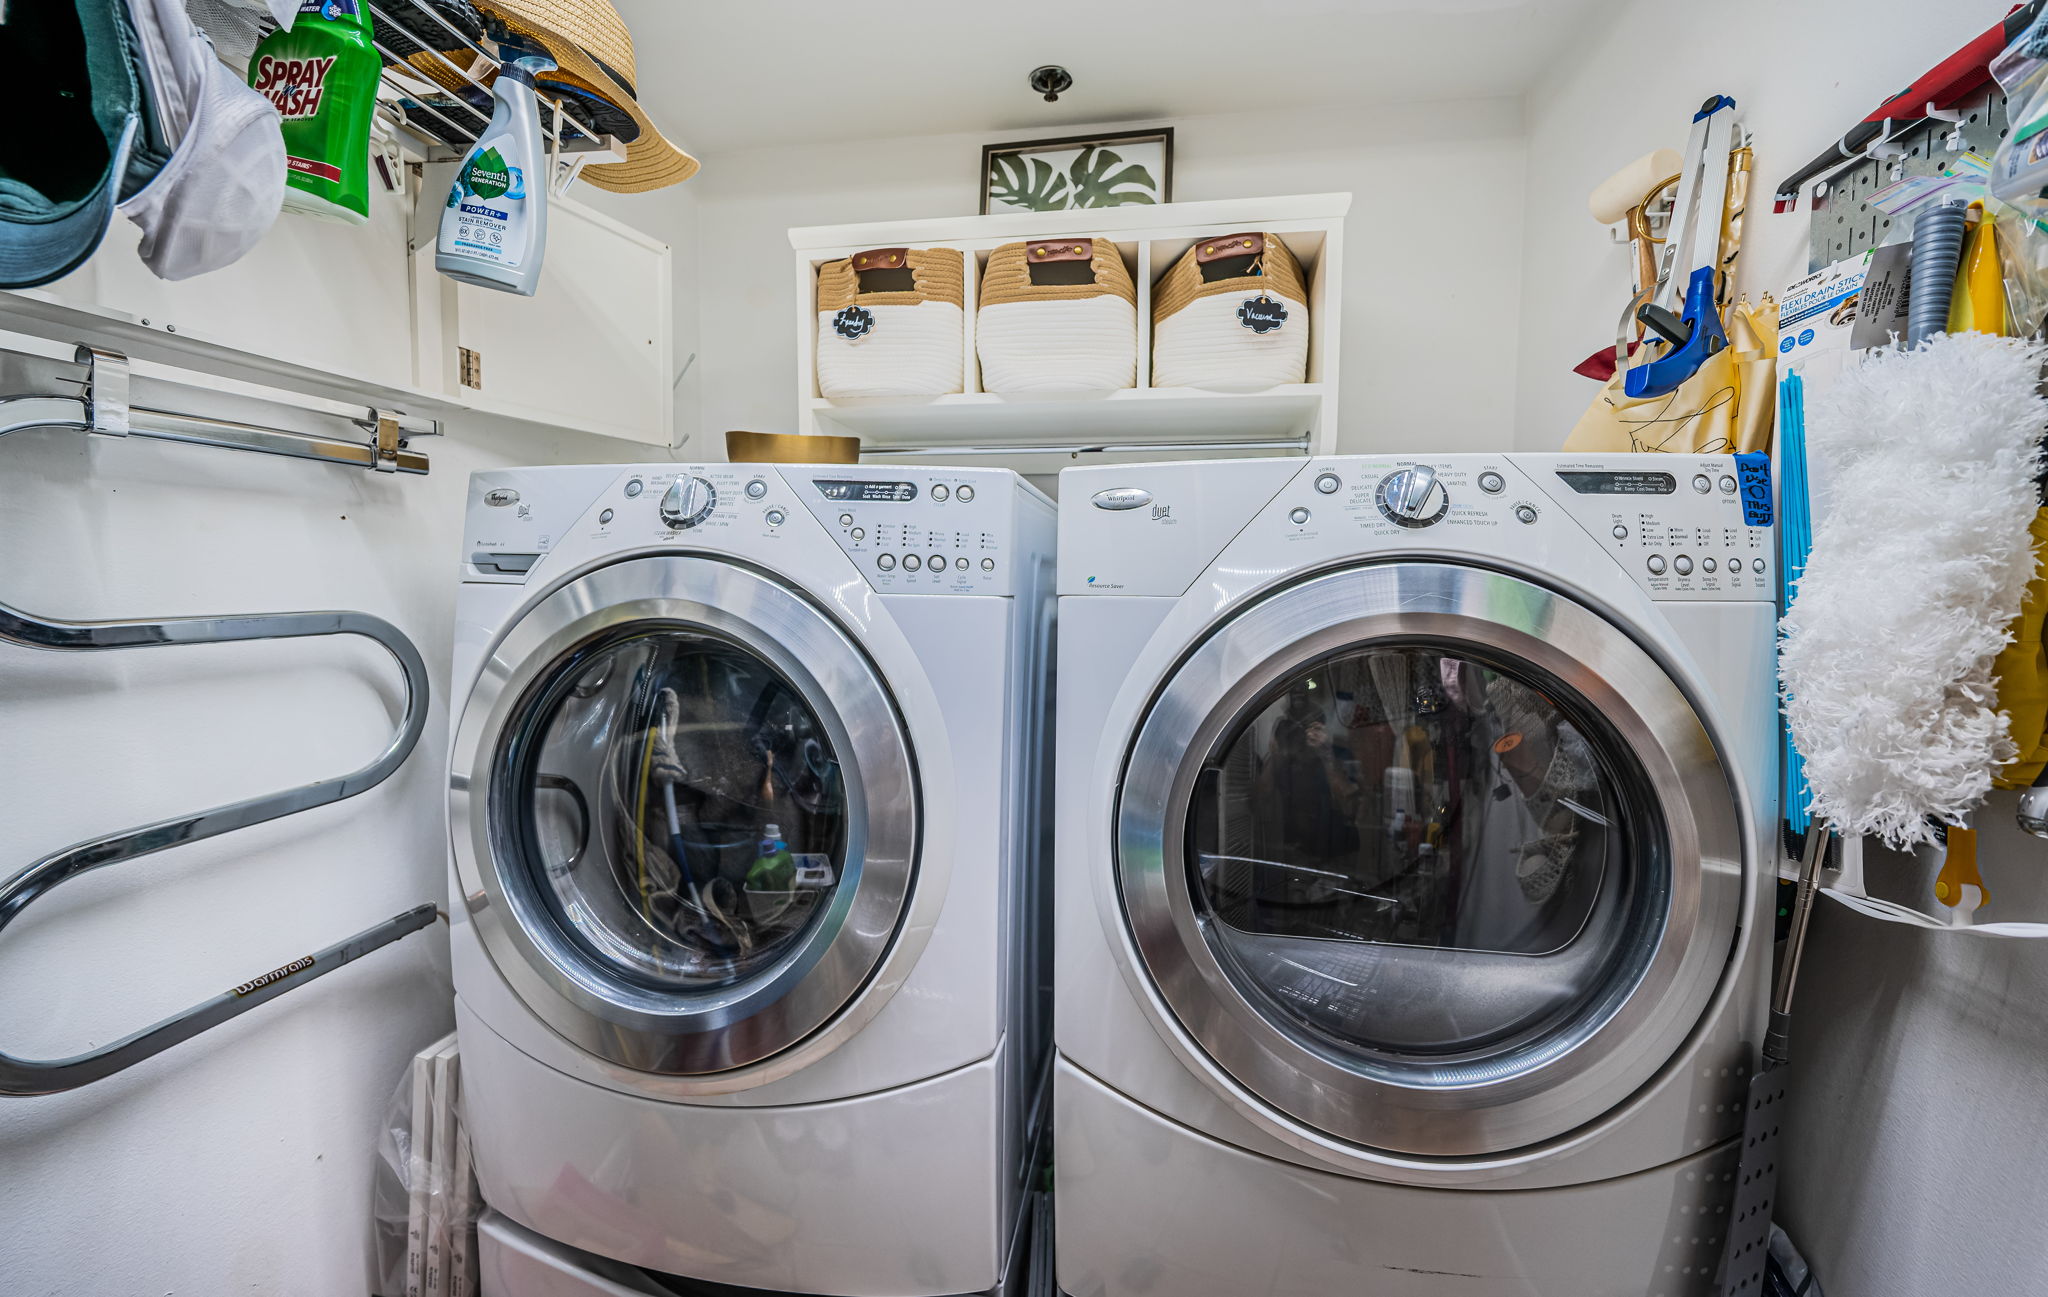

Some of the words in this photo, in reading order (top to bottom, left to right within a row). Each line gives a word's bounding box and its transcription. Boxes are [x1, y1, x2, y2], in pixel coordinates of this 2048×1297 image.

[254, 55, 338, 91] SPRAY
[471, 167, 507, 182] Seventh
[471, 176, 507, 188] GENERATION
[465, 205, 502, 218] POWER+
[458, 216, 474, 224] STAIN
[475, 218, 507, 230] REMOVER
[1780, 299, 1802, 313] FLEXI
[1804, 283, 1836, 303] DRAIN
[1780, 303, 1807, 318] FLEXIBLES
[1808, 298, 1826, 307] POUR
[1835, 283, 1858, 295] DRAIN
[1106, 494, 1135, 503] Whirlpool
[1151, 504, 1170, 518] duet
[1525, 500, 1542, 514] CANCEL
